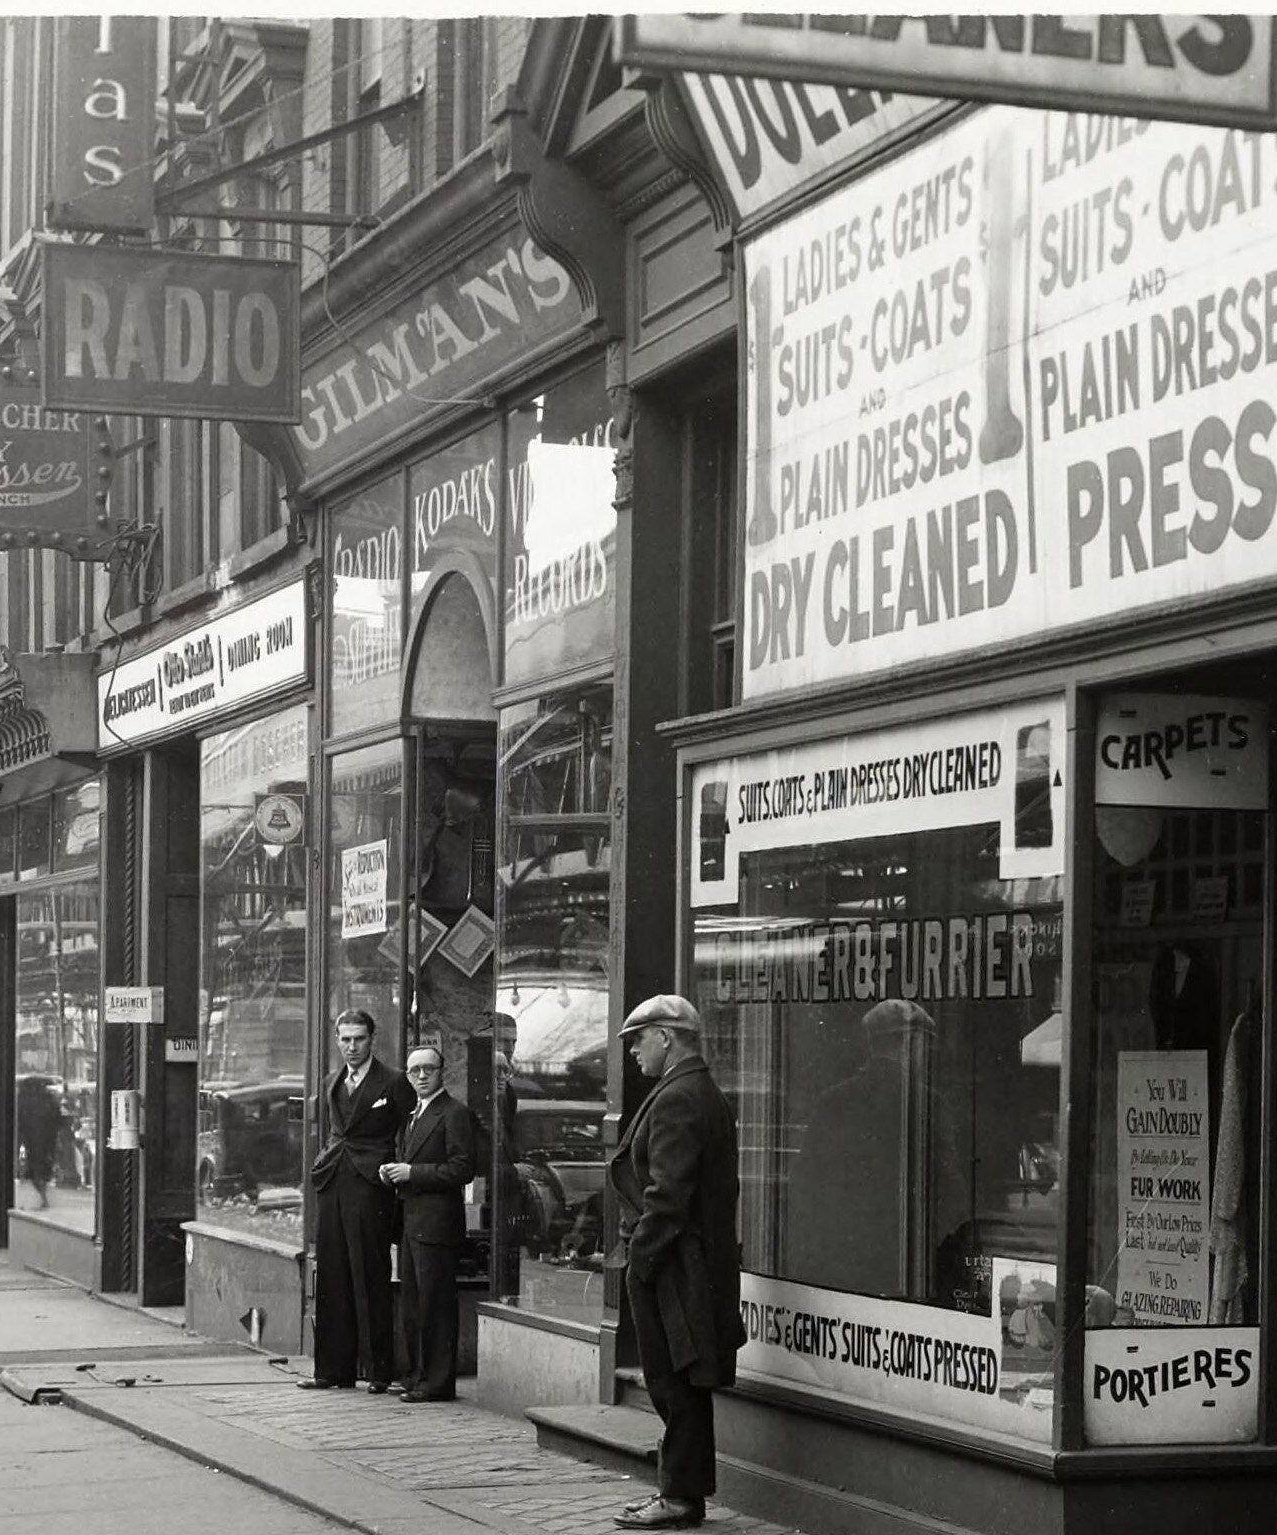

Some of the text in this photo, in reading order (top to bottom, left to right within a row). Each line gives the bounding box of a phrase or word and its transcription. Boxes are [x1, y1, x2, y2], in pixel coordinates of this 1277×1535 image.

[1042, 111, 1152, 183] LADI
[783, 156, 974, 318] LADIES & GENTS
[1039, 178, 1134, 296] SUITS
[1128, 268, 1166, 307] AND
[64, 276, 281, 389] RADIO
[290, 238, 570, 451] GILMAN'S
[777, 314, 853, 417] SUITS
[870, 257, 973, 372] COATS
[858, 387, 887, 418] AND
[1041, 323, 1140, 442] PLAIN
[780, 391, 972, 535] PLAIN DRESSES
[749, 488, 1018, 671] DRY CLEANED
[227, 632, 260, 671] DINING
[1101, 712, 1249, 780] CARPETS
[813, 767, 848, 812] PLAIN
[850, 758, 901, 808] DRESSES
[110, 995, 148, 1009] APARTMENT
[1126, 1107, 1203, 1135] GAIN DOUBLY
[1131, 1177, 1201, 1200] FUR WORK
[1165, 1272, 1178, 1290] Do
[841, 1322, 881, 1370] SUITS
[890, 1331, 932, 1381] COATS
[934, 1339, 998, 1395] PRESSED
[1093, 1347, 1251, 1408] PORTIERES
